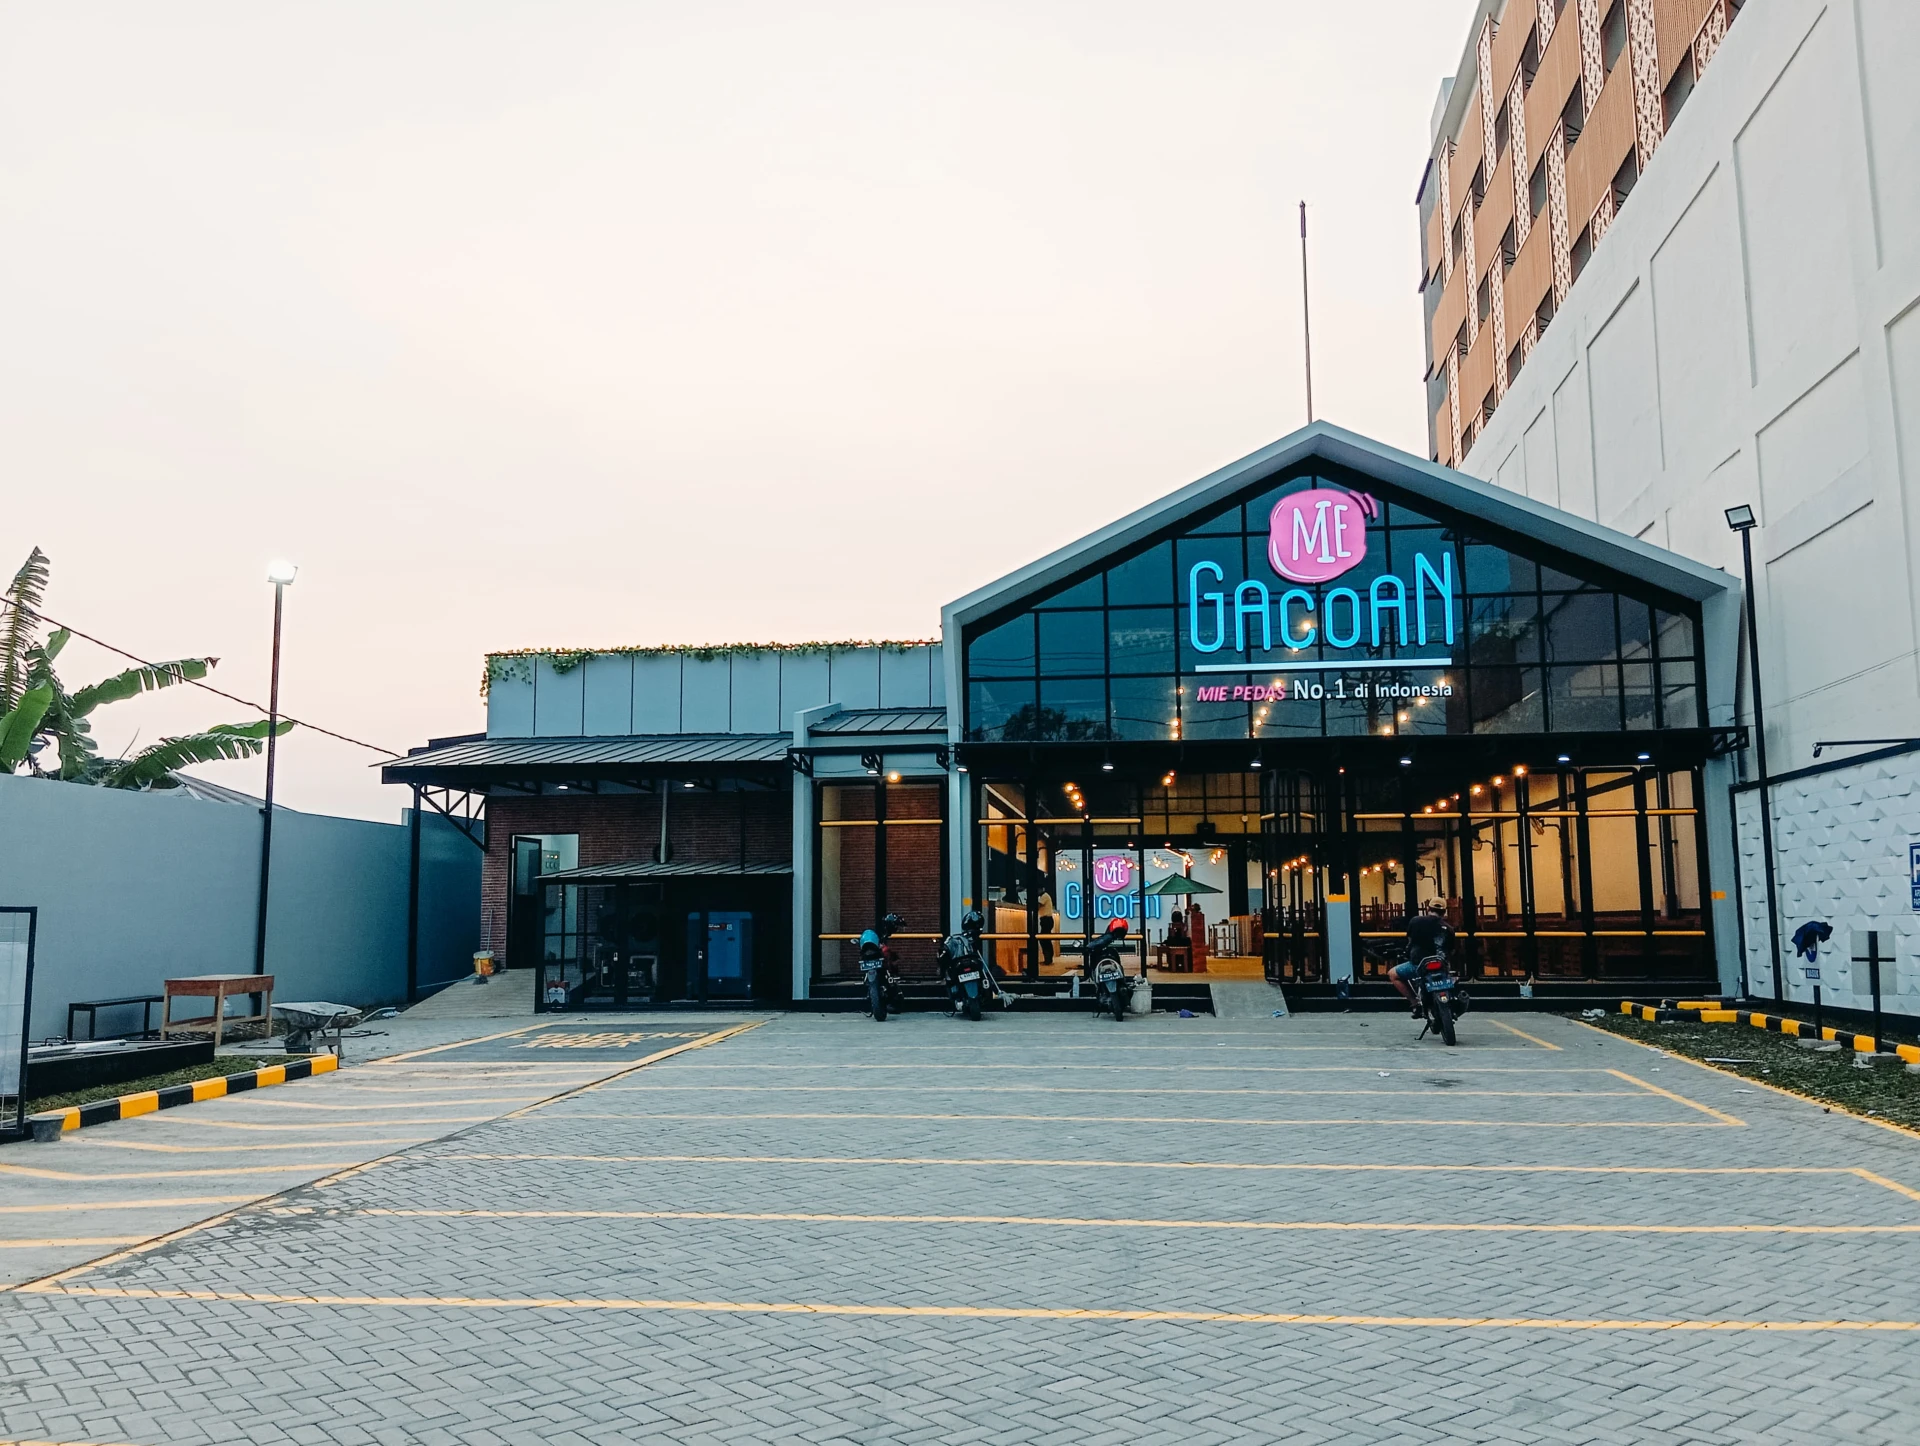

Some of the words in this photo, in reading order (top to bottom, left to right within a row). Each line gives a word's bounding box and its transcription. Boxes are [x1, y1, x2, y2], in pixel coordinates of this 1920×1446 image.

[1189, 551, 1455, 653] GACOAN
[1197, 686, 1228, 702] MIE
[1233, 685, 1287, 701] PEDAS
[1293, 678, 1347, 700] No.1
[1354, 682, 1369, 699] di
[1375, 681, 1453, 698] Indonesia
